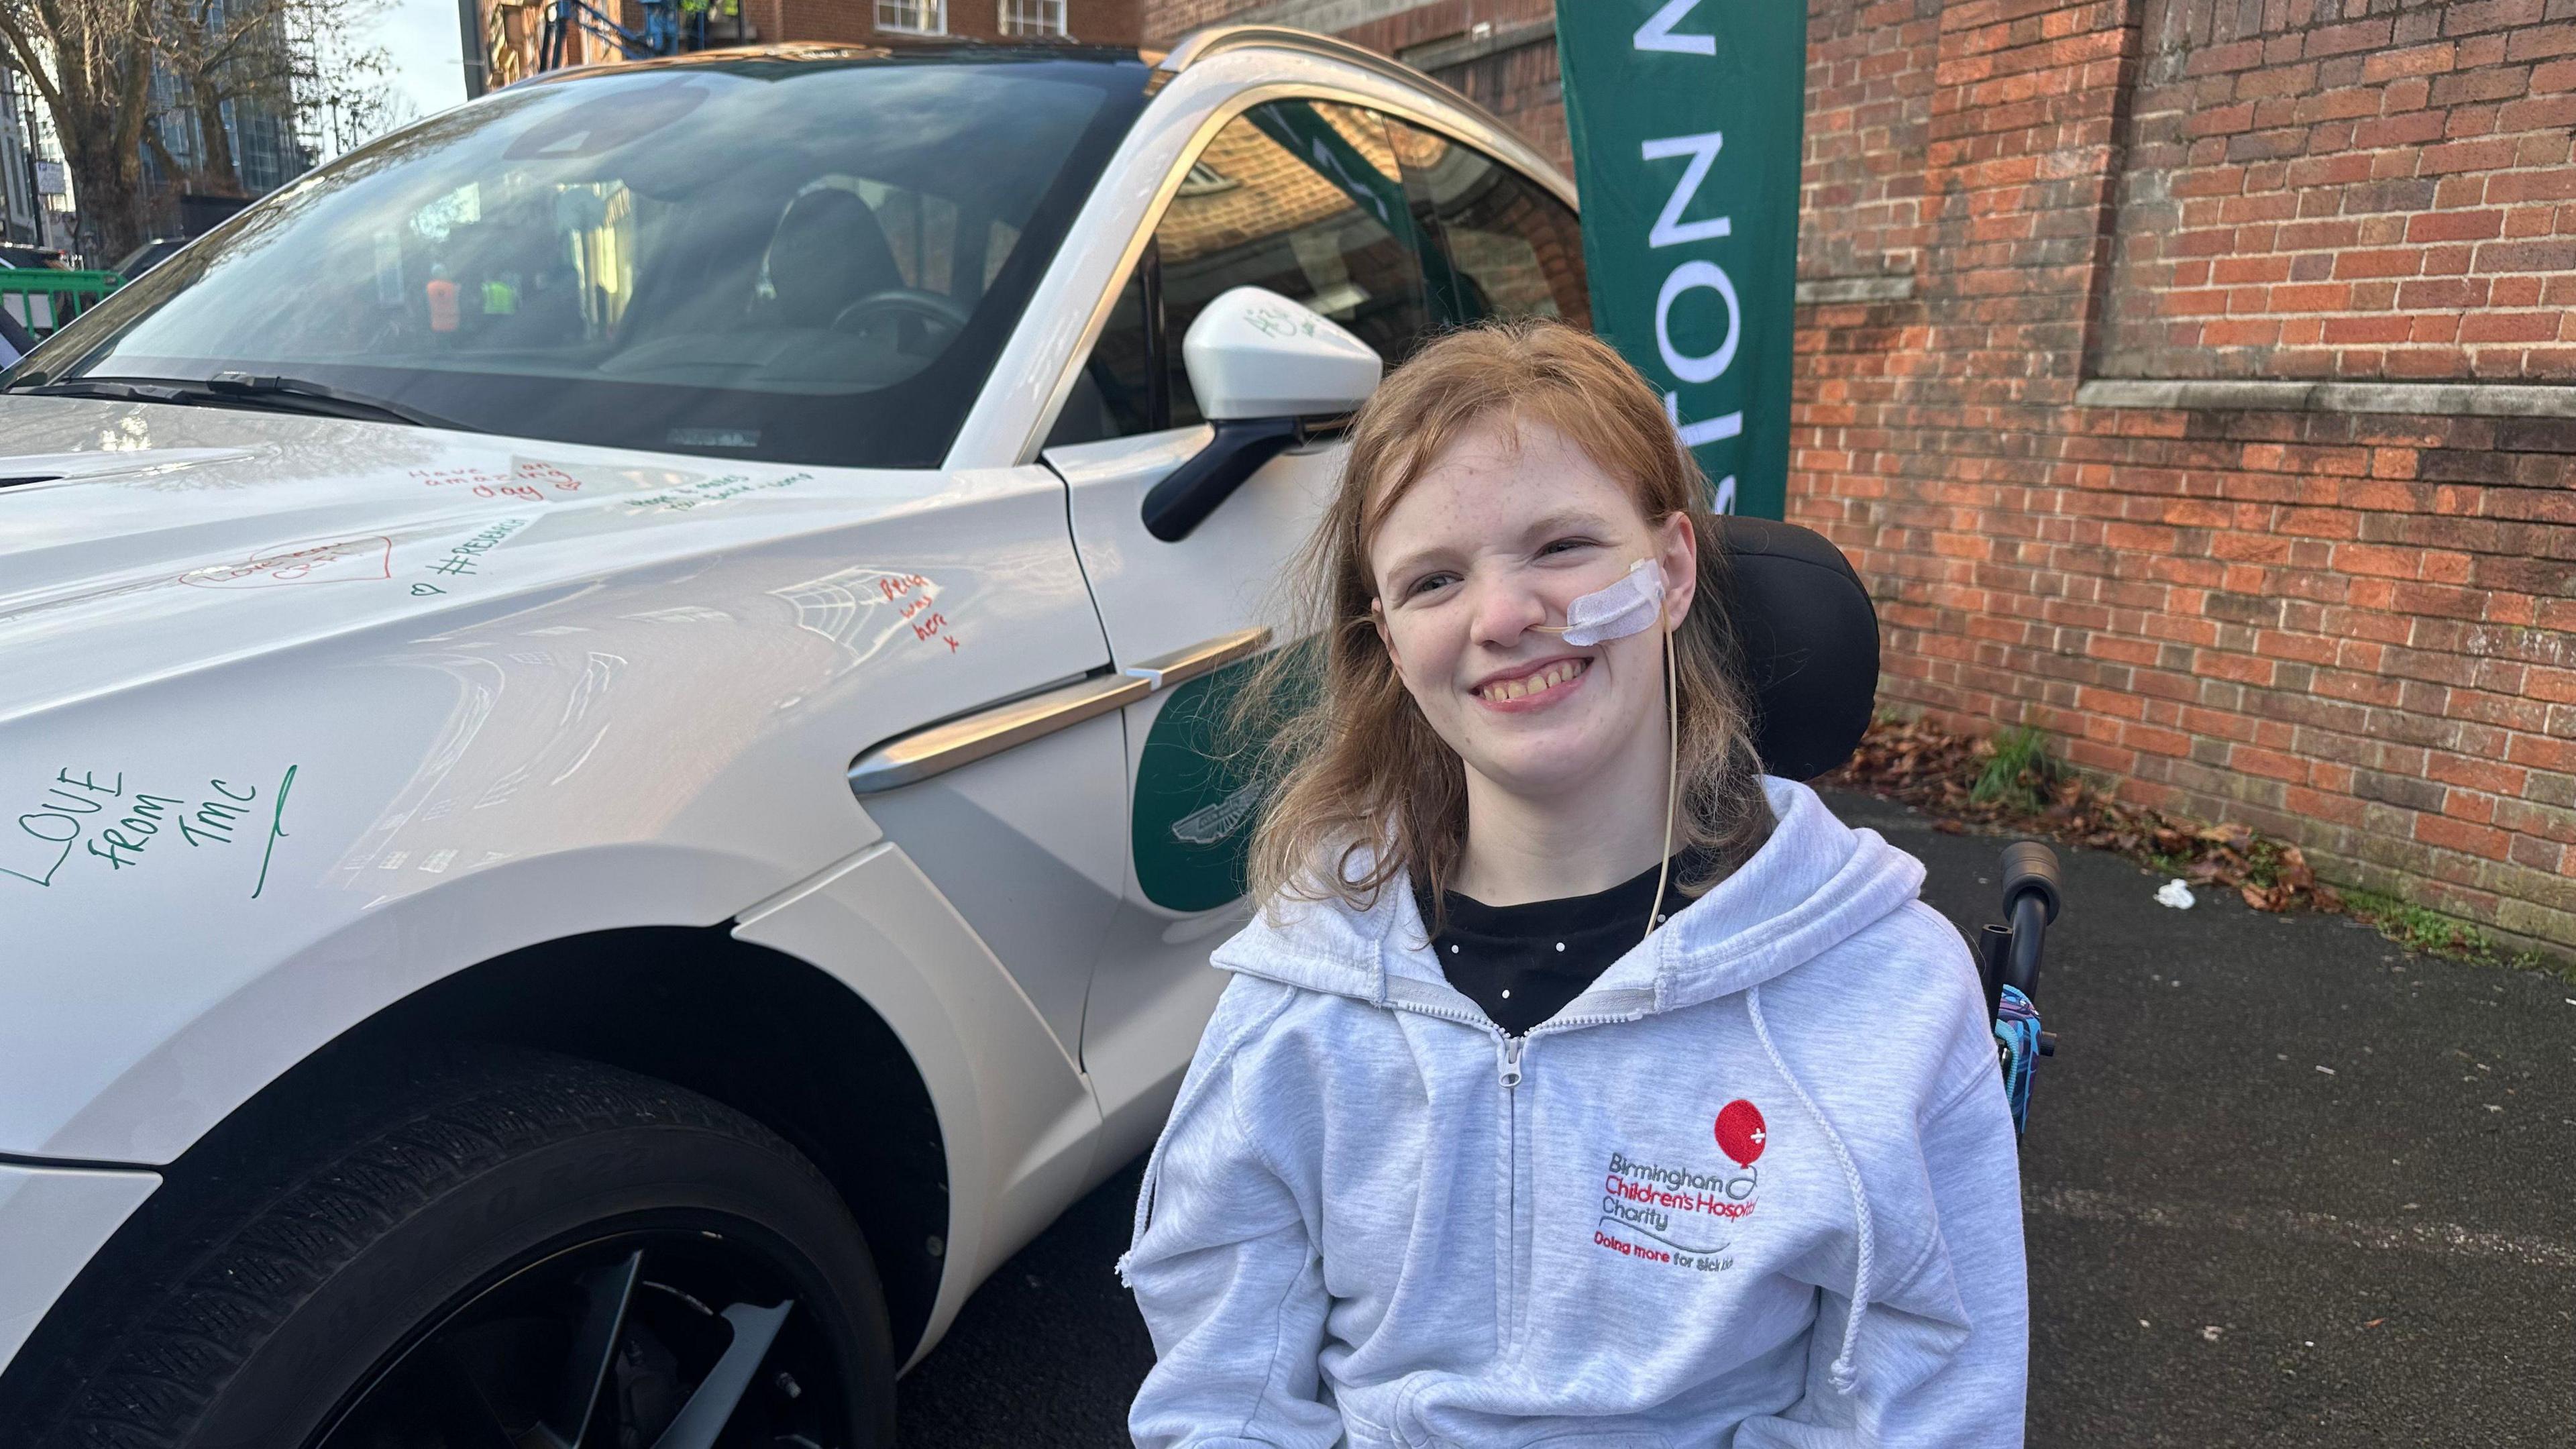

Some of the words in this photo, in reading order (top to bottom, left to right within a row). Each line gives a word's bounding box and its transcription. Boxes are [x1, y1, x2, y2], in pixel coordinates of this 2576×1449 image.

[1642, 131, 1743, 515] TON
[472, 484, 545, 502] day
[425, 519, 529, 576] #RESEARCH
[0, 767, 122, 887] LOVE
[178, 779, 256, 847] TMC
[1605, 1175, 1694, 1212] Children's
[1609, 1152, 1723, 1193] Birmingham
[1602, 1195, 1668, 1231] Charity
[1594, 1230, 1631, 1256] Doing
[1634, 1244, 1670, 1263] more
[1673, 1252, 1694, 1268] for
[1696, 1256, 1719, 1272] sick
